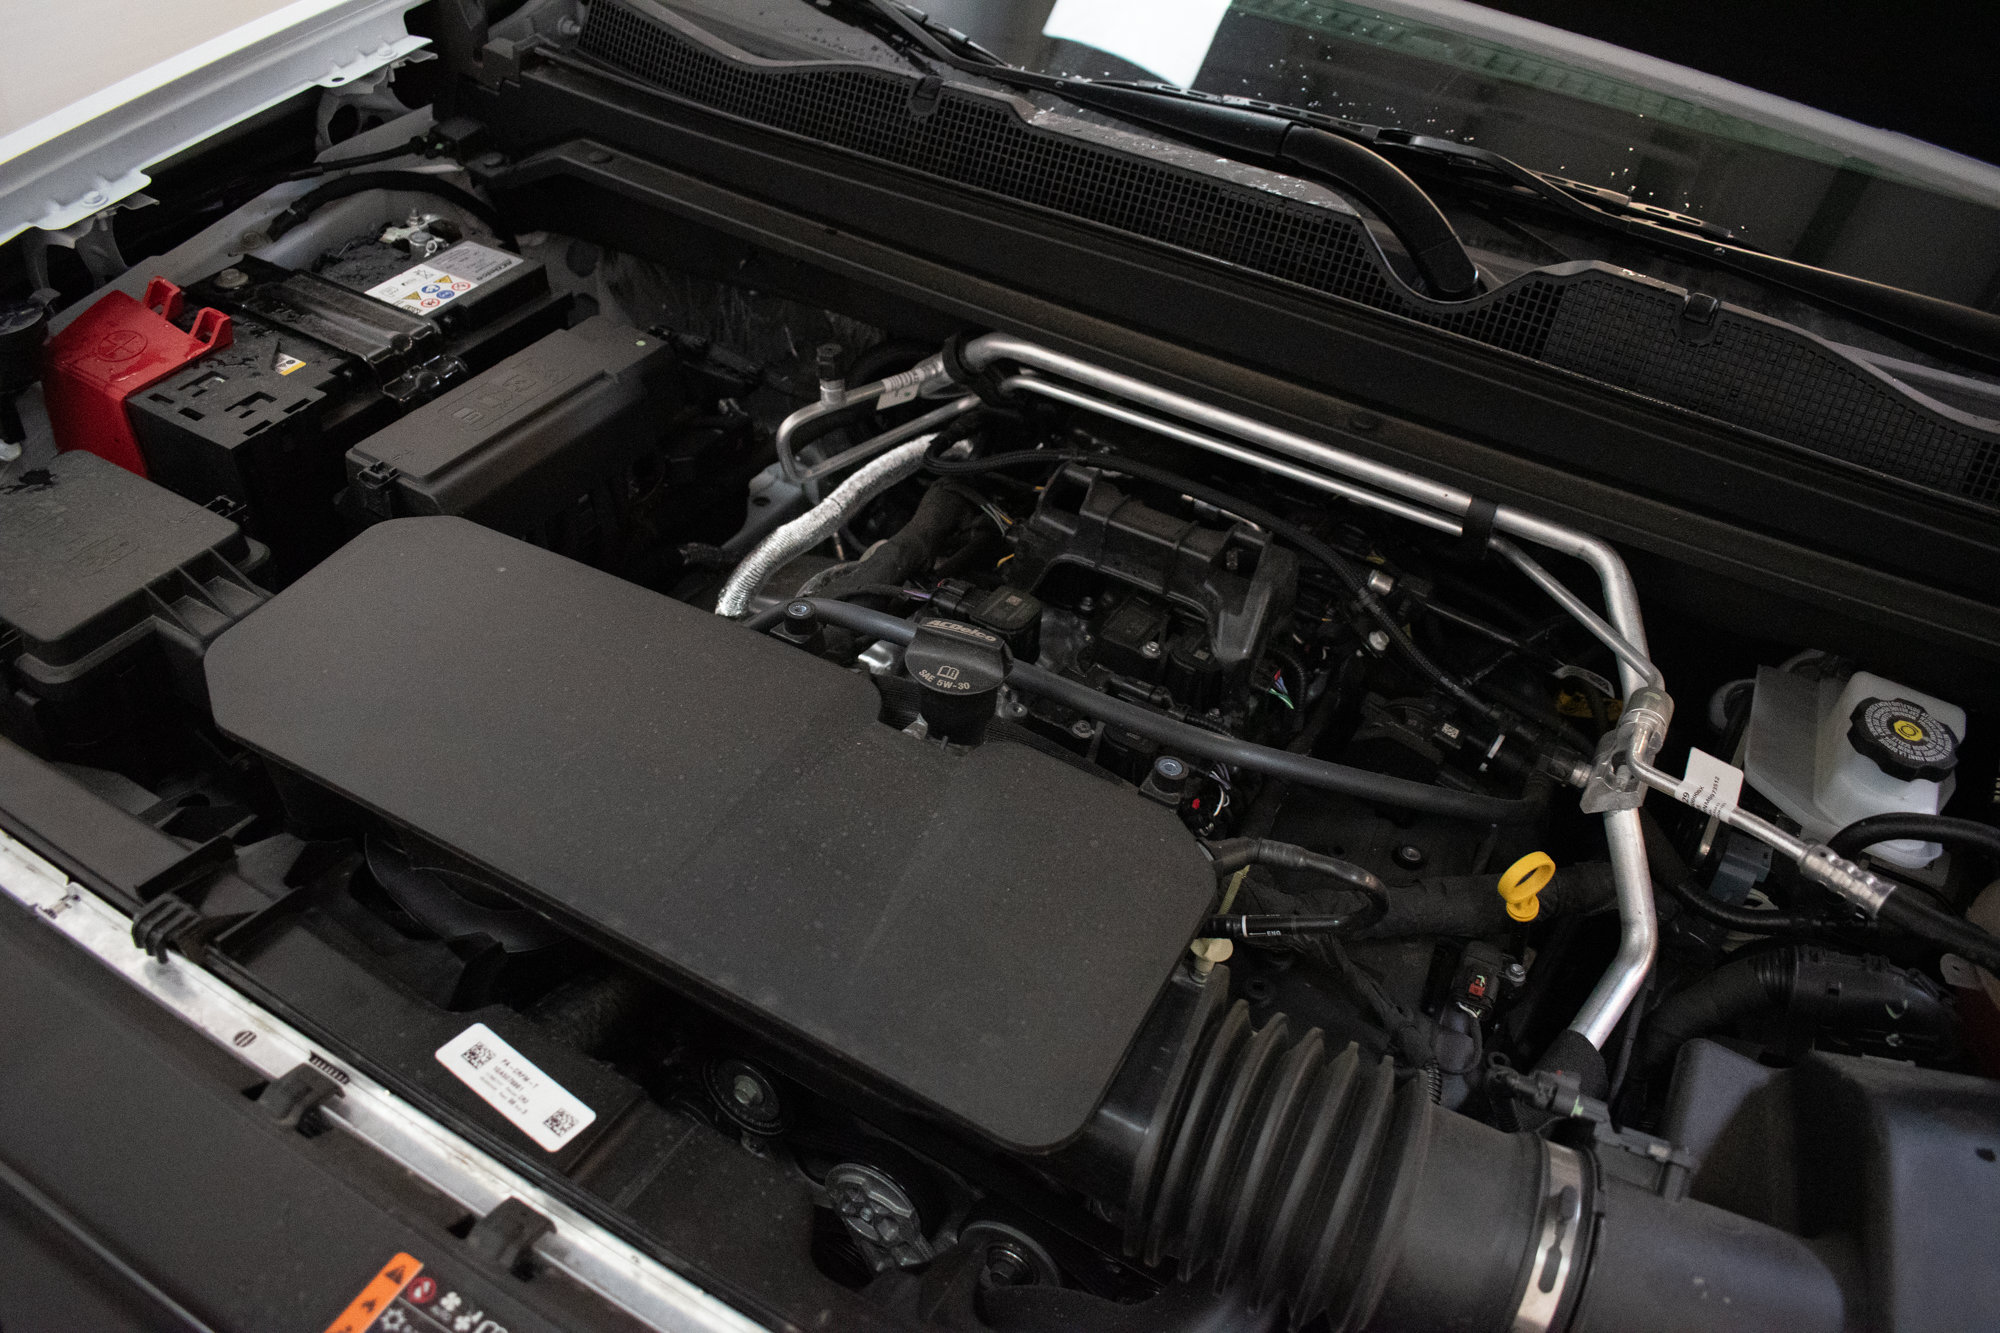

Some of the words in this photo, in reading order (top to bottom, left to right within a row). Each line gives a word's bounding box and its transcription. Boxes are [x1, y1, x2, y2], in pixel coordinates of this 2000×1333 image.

[923, 619, 997, 642] ACDelco
[918, 668, 936, 683] SAE
[936, 678, 971, 690] 5W-30
